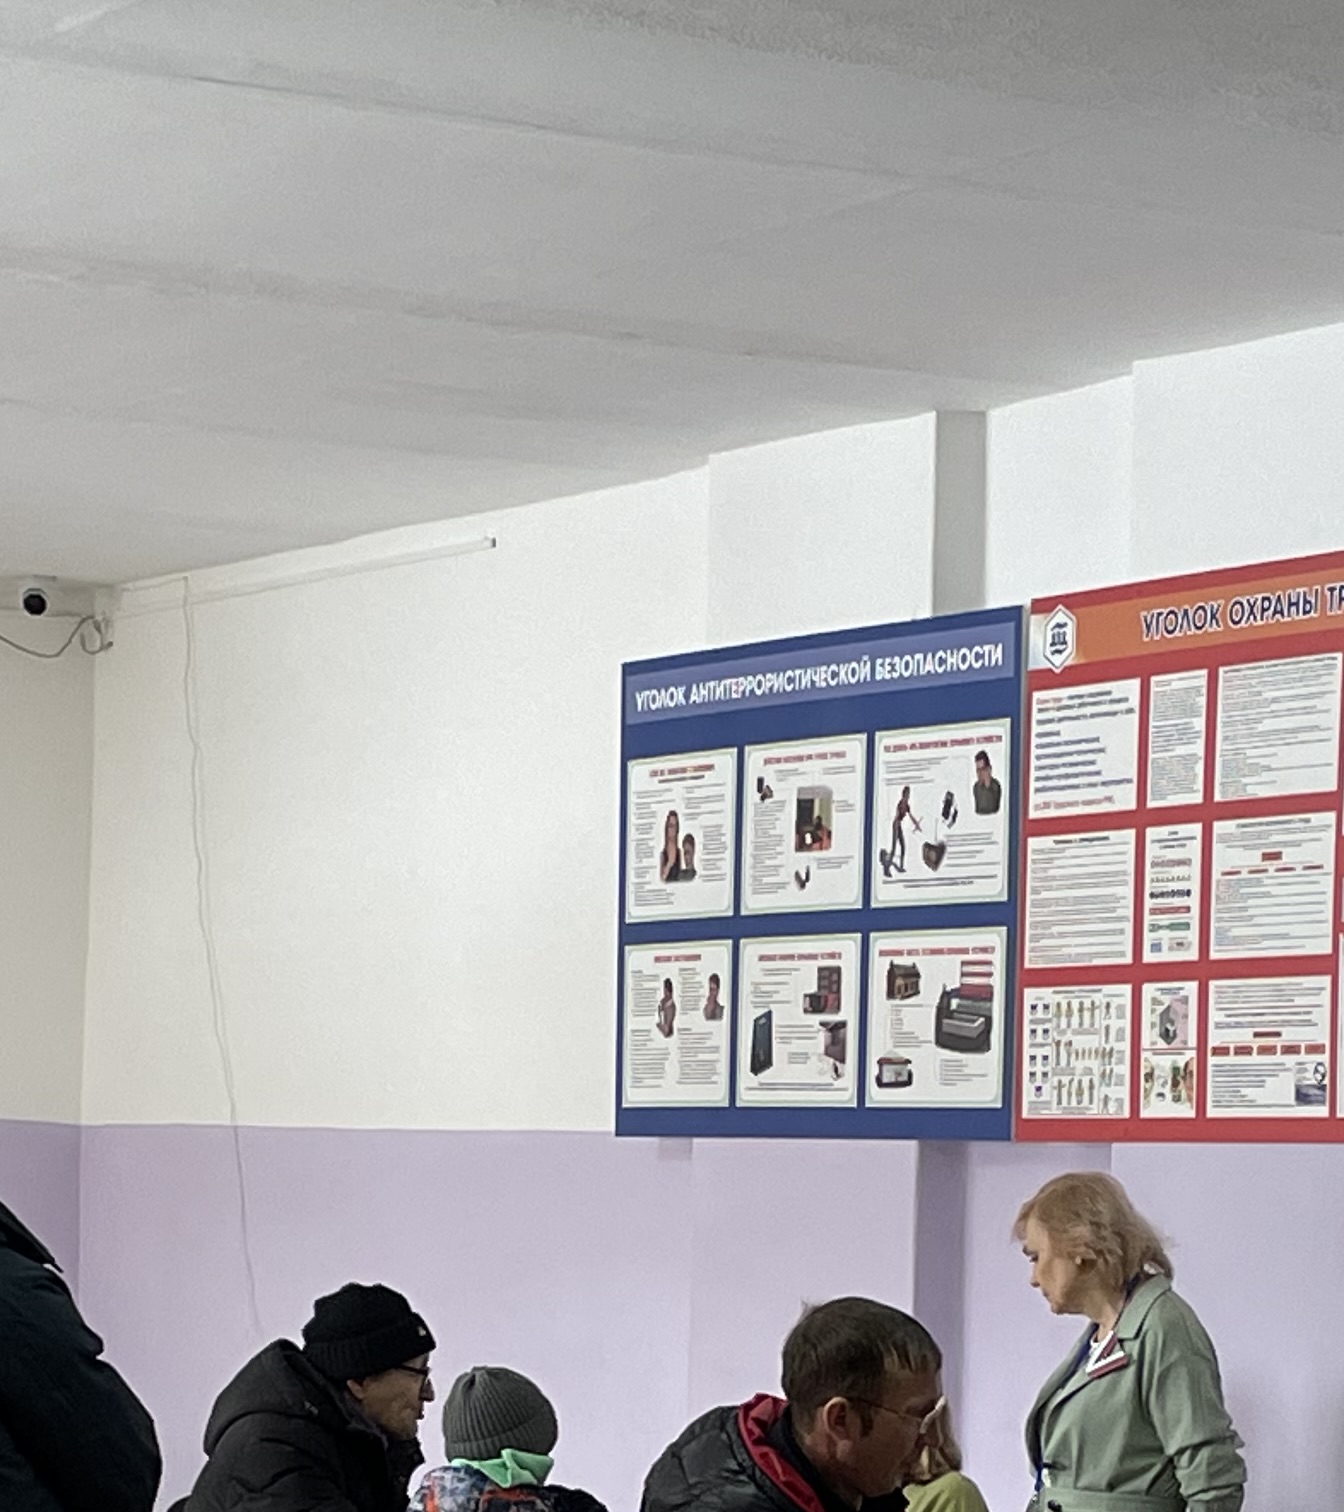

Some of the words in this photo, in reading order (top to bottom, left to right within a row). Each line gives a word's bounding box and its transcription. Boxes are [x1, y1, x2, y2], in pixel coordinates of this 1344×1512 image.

[1143, 603, 1222, 638] УГОЛОК
[1228, 587, 1320, 626] ОХРАНЫ
[635, 685, 687, 713] УГОЛОК
[689, 654, 872, 706] АНТИТЕРРОРИСТИЧЕСКОЙ
[874, 642, 1004, 681] БЕЗОПАСНОСТИ
